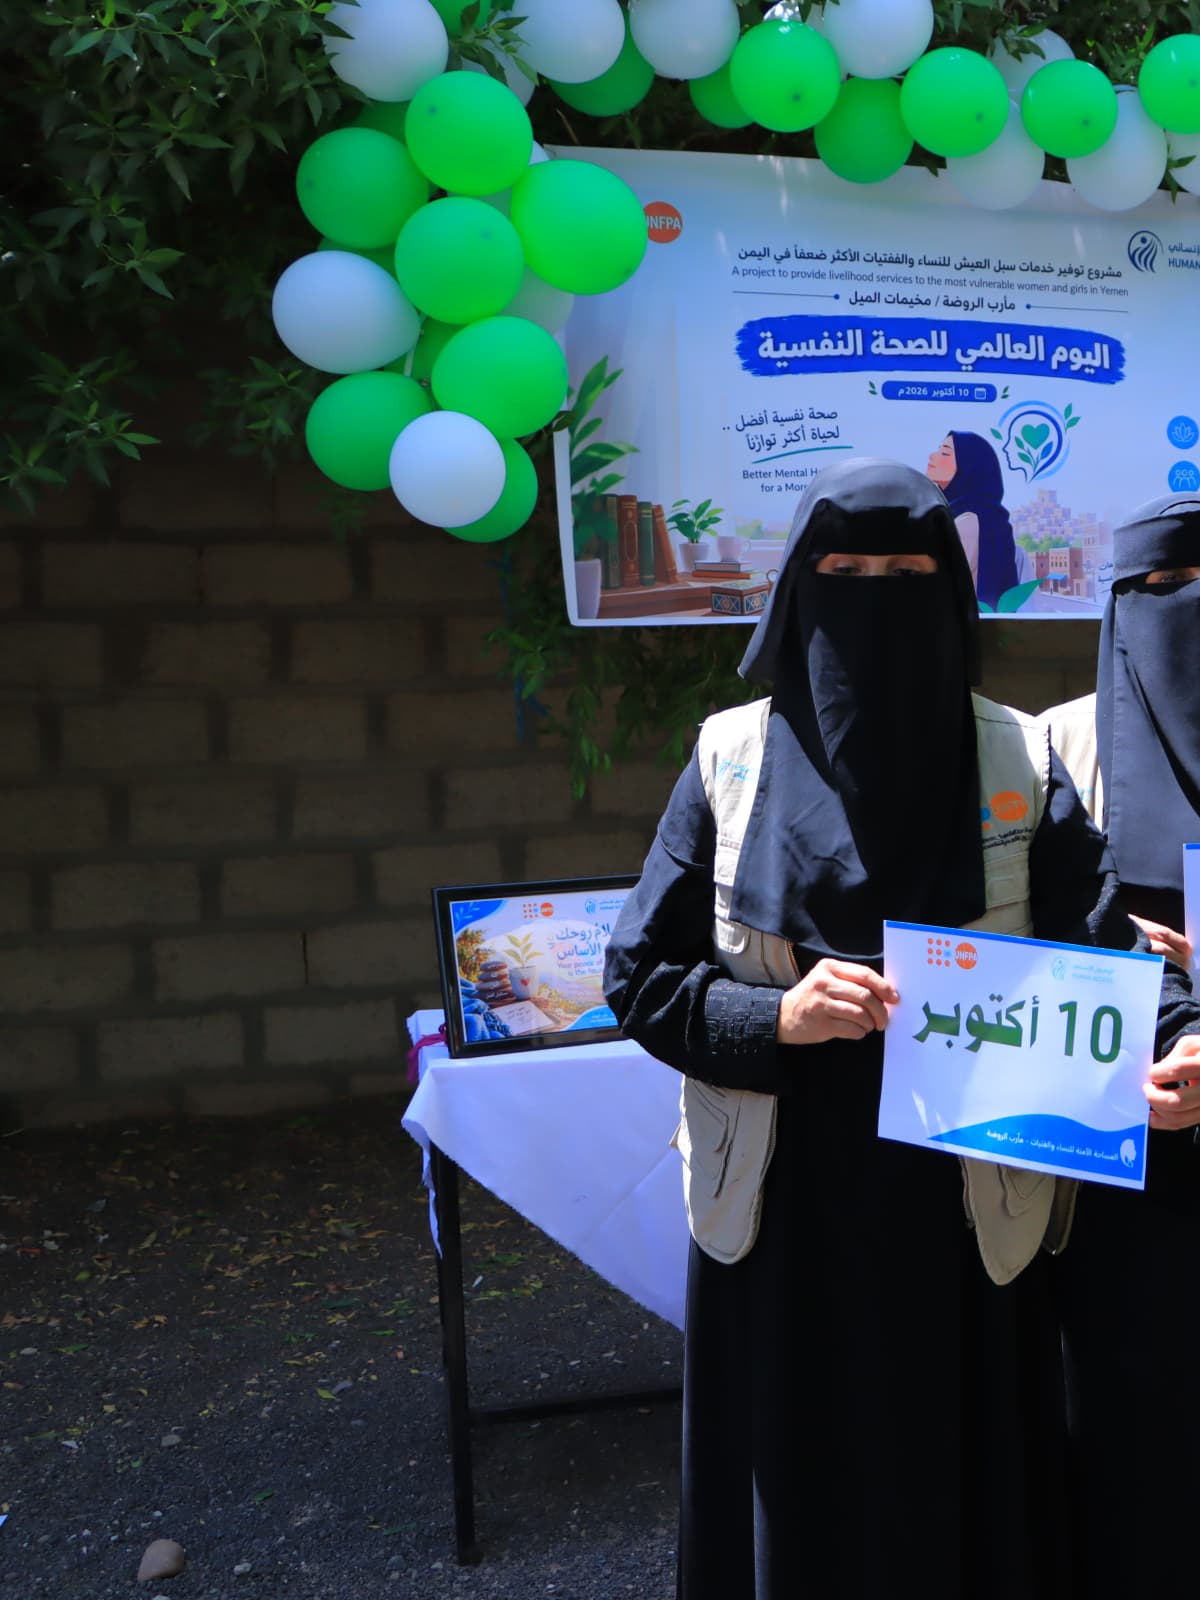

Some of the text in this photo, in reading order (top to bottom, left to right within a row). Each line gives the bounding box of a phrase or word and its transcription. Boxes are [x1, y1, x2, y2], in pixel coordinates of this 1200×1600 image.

[738, 247, 770, 262] اليمن
[773, 248, 791, 264] في
[830, 248, 860, 264] الأكثر
[918, 256, 951, 267] للنساء
[954, 256, 990, 272] العيش
[994, 261, 1016, 275] سبل
[1019, 262, 1054, 273] خدمات
[1057, 265, 1084, 279] توفير
[1087, 267, 1122, 280] مشروع
[732, 266, 1129, 297] A project to provide livelihood services to the most vulnerable women and girls in Yemen
[849, 290, 1016, 312] مأرب الروضة / مخيمات الميل
[758, 329, 1110, 374] اليوم العالمي للصحة النفسية
[932, 385, 956, 397] أكتوبر
[959, 388, 969, 397] 10
[735, 410, 768, 432] أفضل
[772, 409, 804, 426] نفسية
[808, 408, 838, 420] صحة
[782, 424, 806, 448] أكثر
[811, 425, 840, 443] لحياة
[742, 469, 772, 479] Better
[775, 468, 808, 478] Mental
[761, 483, 774, 492] for
[911, 993, 1123, 1063] 10 أكتوبر
